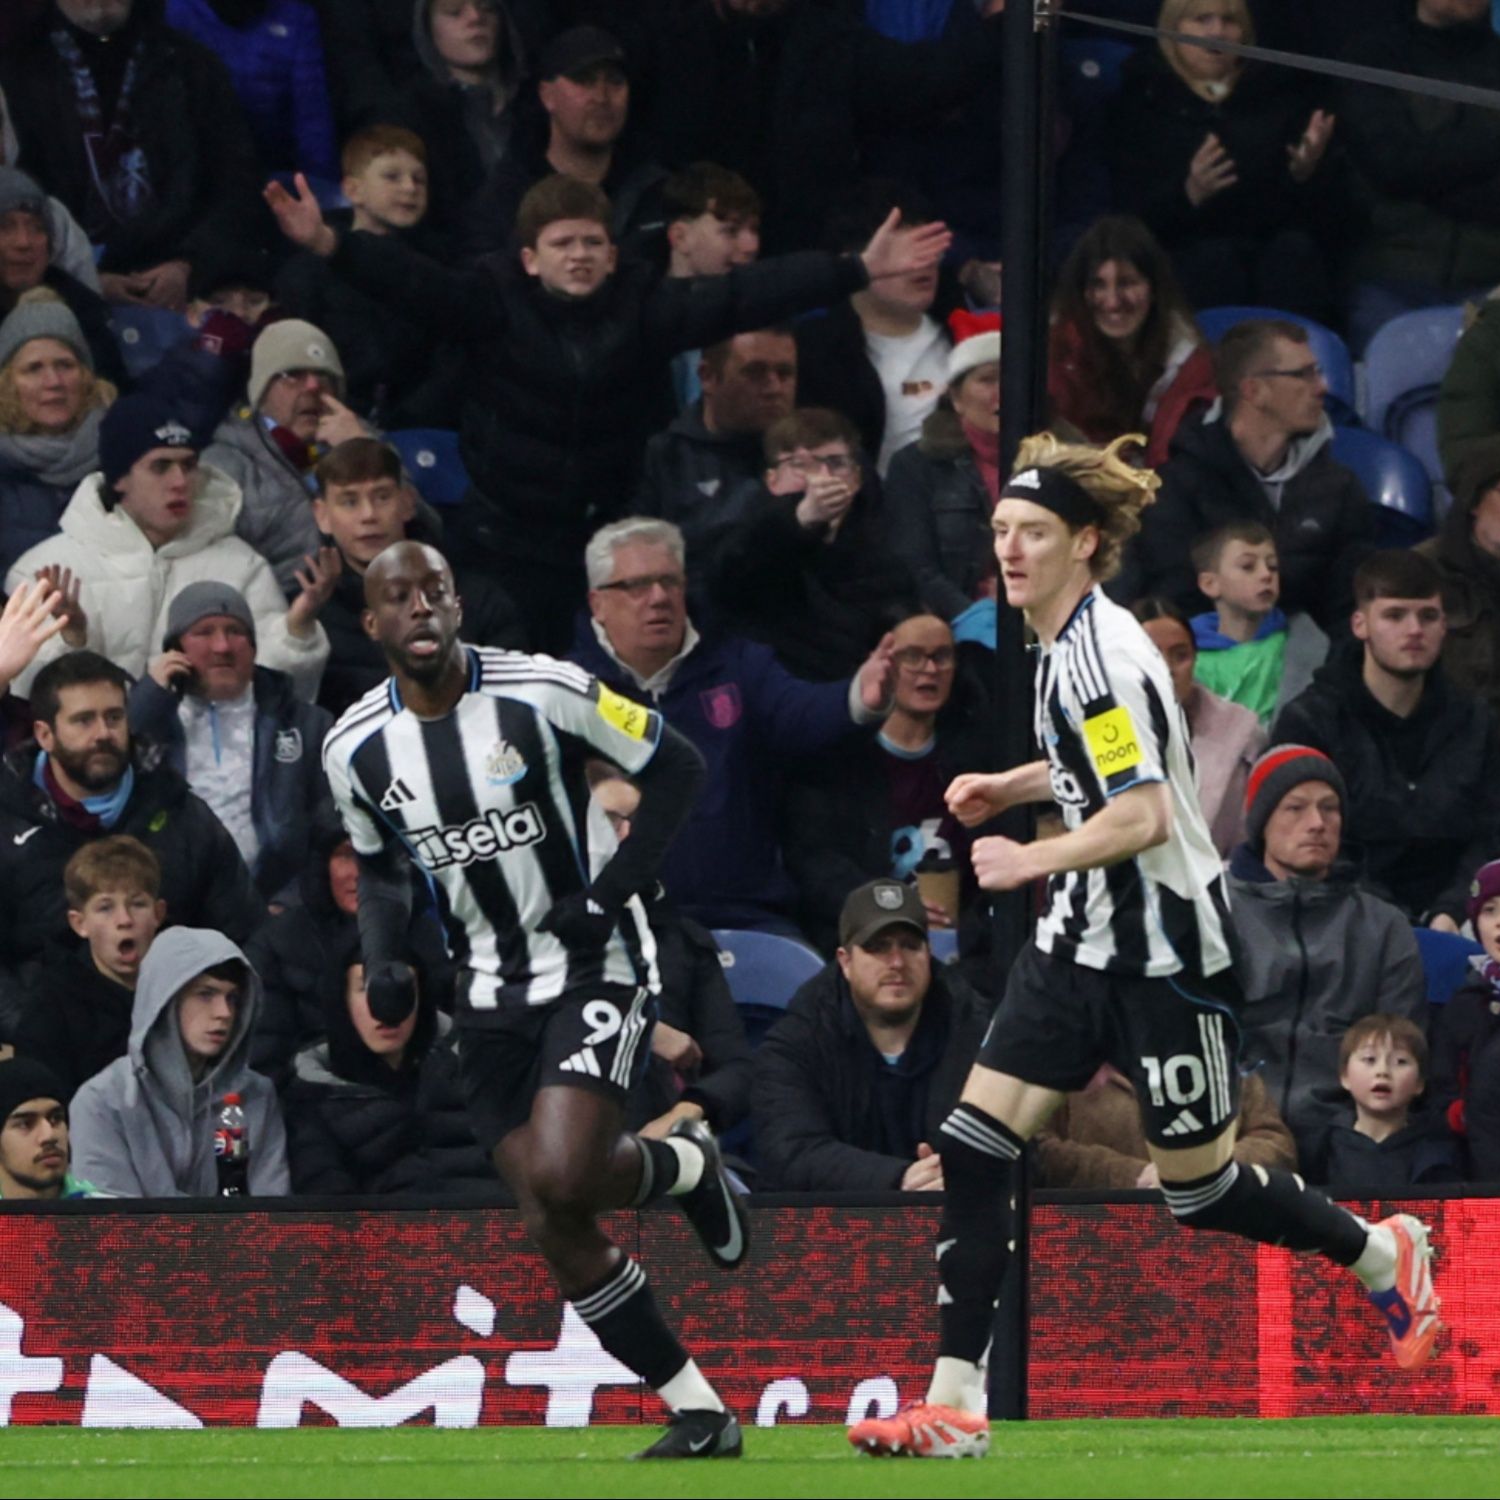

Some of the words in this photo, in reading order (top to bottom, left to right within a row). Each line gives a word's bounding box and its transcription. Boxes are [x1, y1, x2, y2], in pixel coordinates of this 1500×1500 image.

[1095, 741, 1138, 766] noon
[582, 999, 623, 1046] 9
[1140, 1053, 1207, 1107] 10
